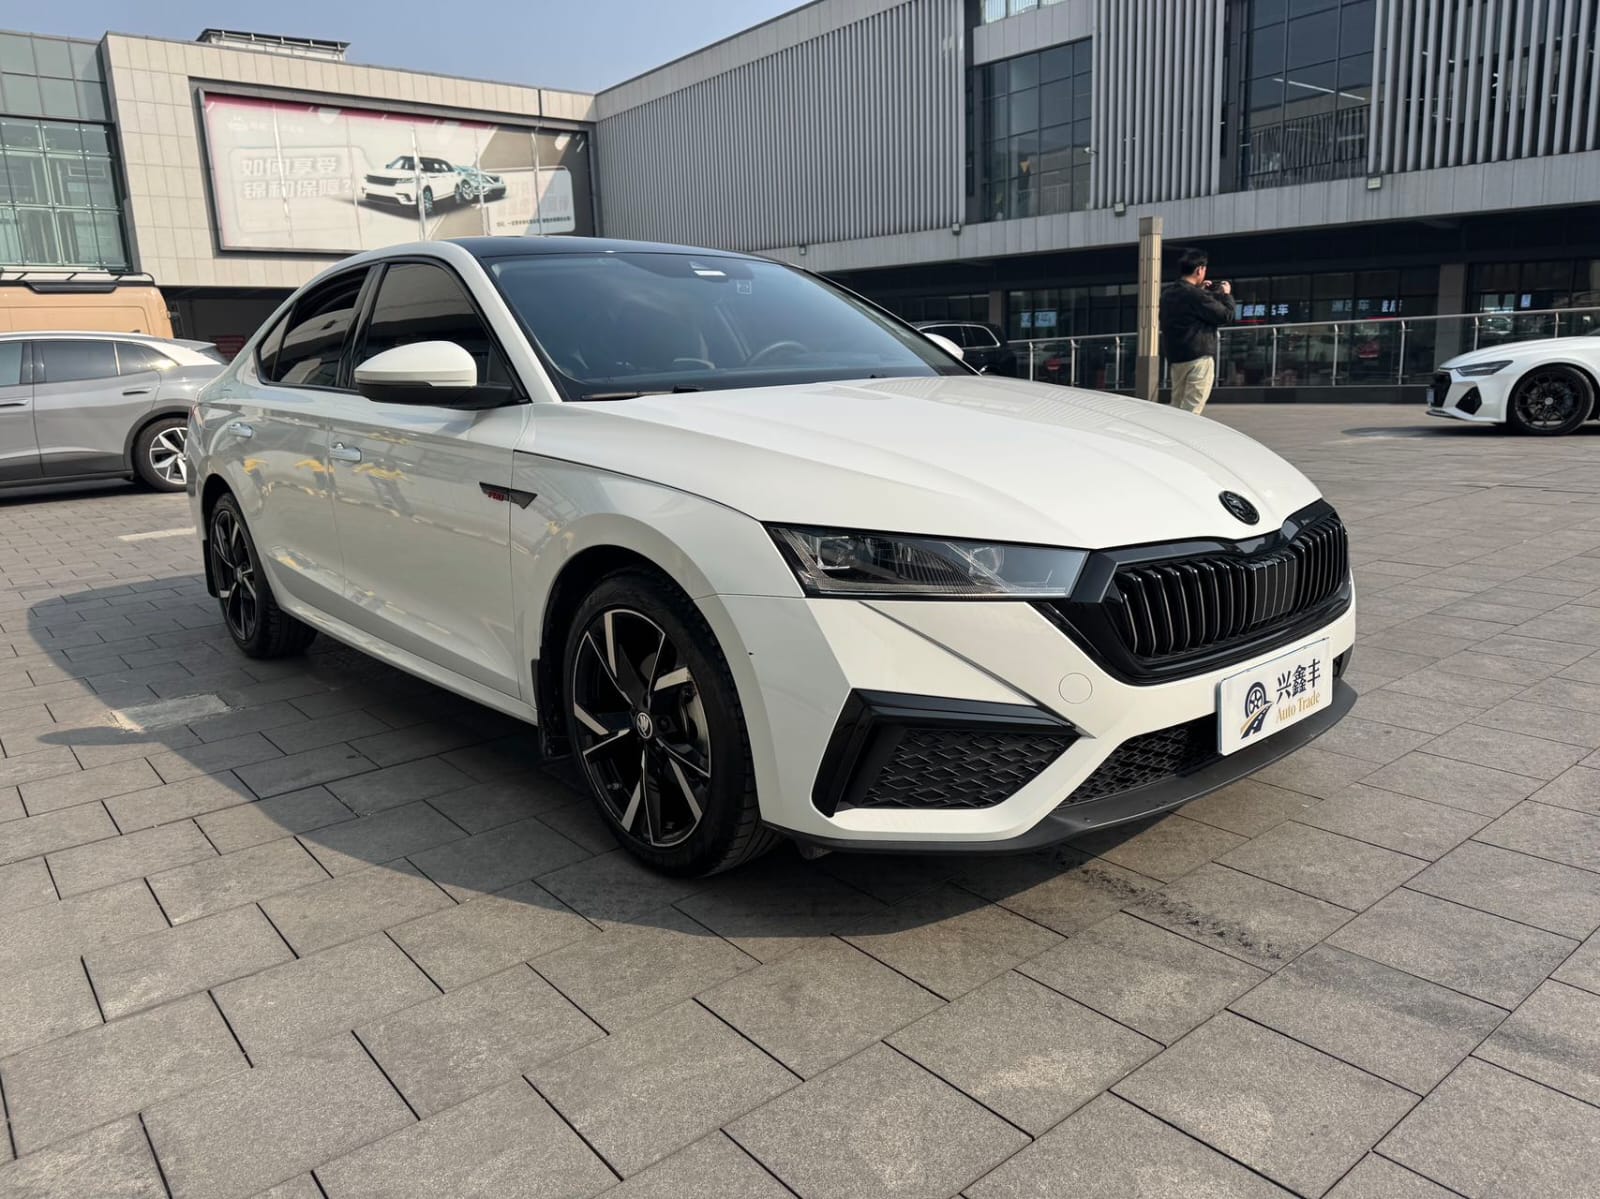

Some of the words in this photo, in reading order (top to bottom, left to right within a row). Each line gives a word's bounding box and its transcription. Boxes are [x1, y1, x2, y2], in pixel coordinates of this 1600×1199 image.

[240, 156, 337, 177] 如何享受
[1276, 658, 1321, 704] 兴鑫丰
[1276, 703, 1297, 723] Auto
[1298, 691, 1321, 713] Trade
